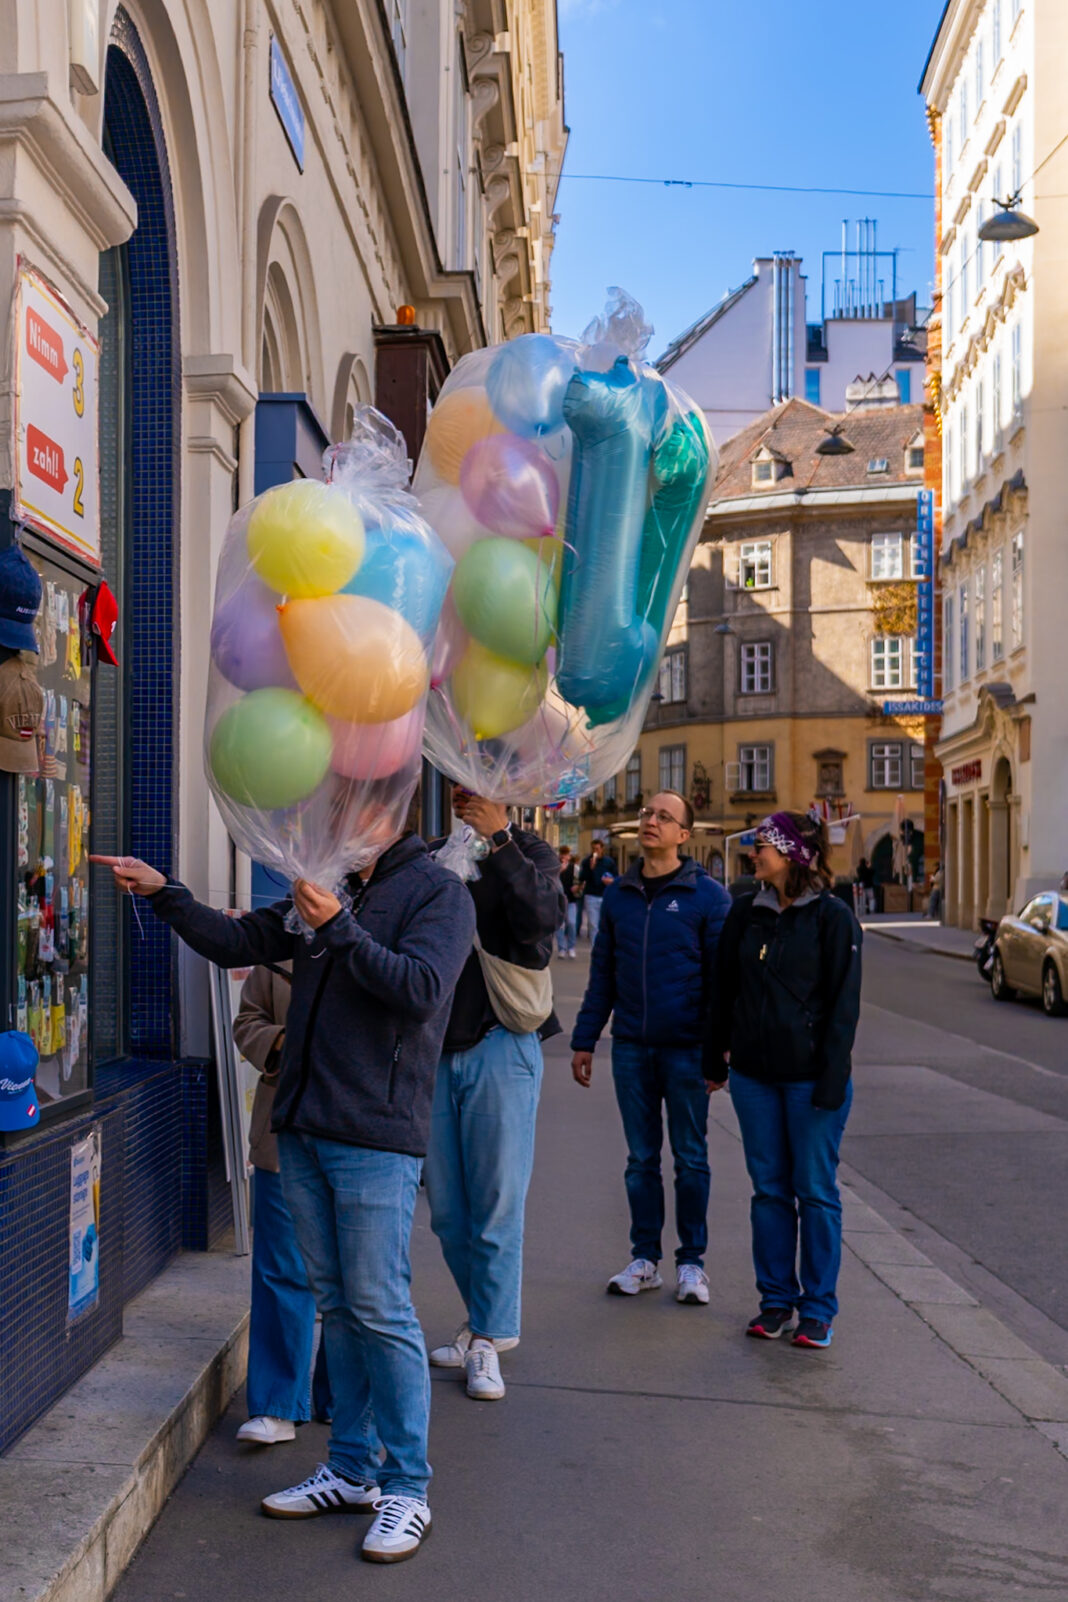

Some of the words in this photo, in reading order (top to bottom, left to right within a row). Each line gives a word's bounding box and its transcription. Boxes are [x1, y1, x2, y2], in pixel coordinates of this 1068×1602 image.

[29, 317, 59, 368] Nimm
[72, 347, 85, 418] 3
[33, 445, 59, 480] zahl!
[73, 456, 84, 519] 2
